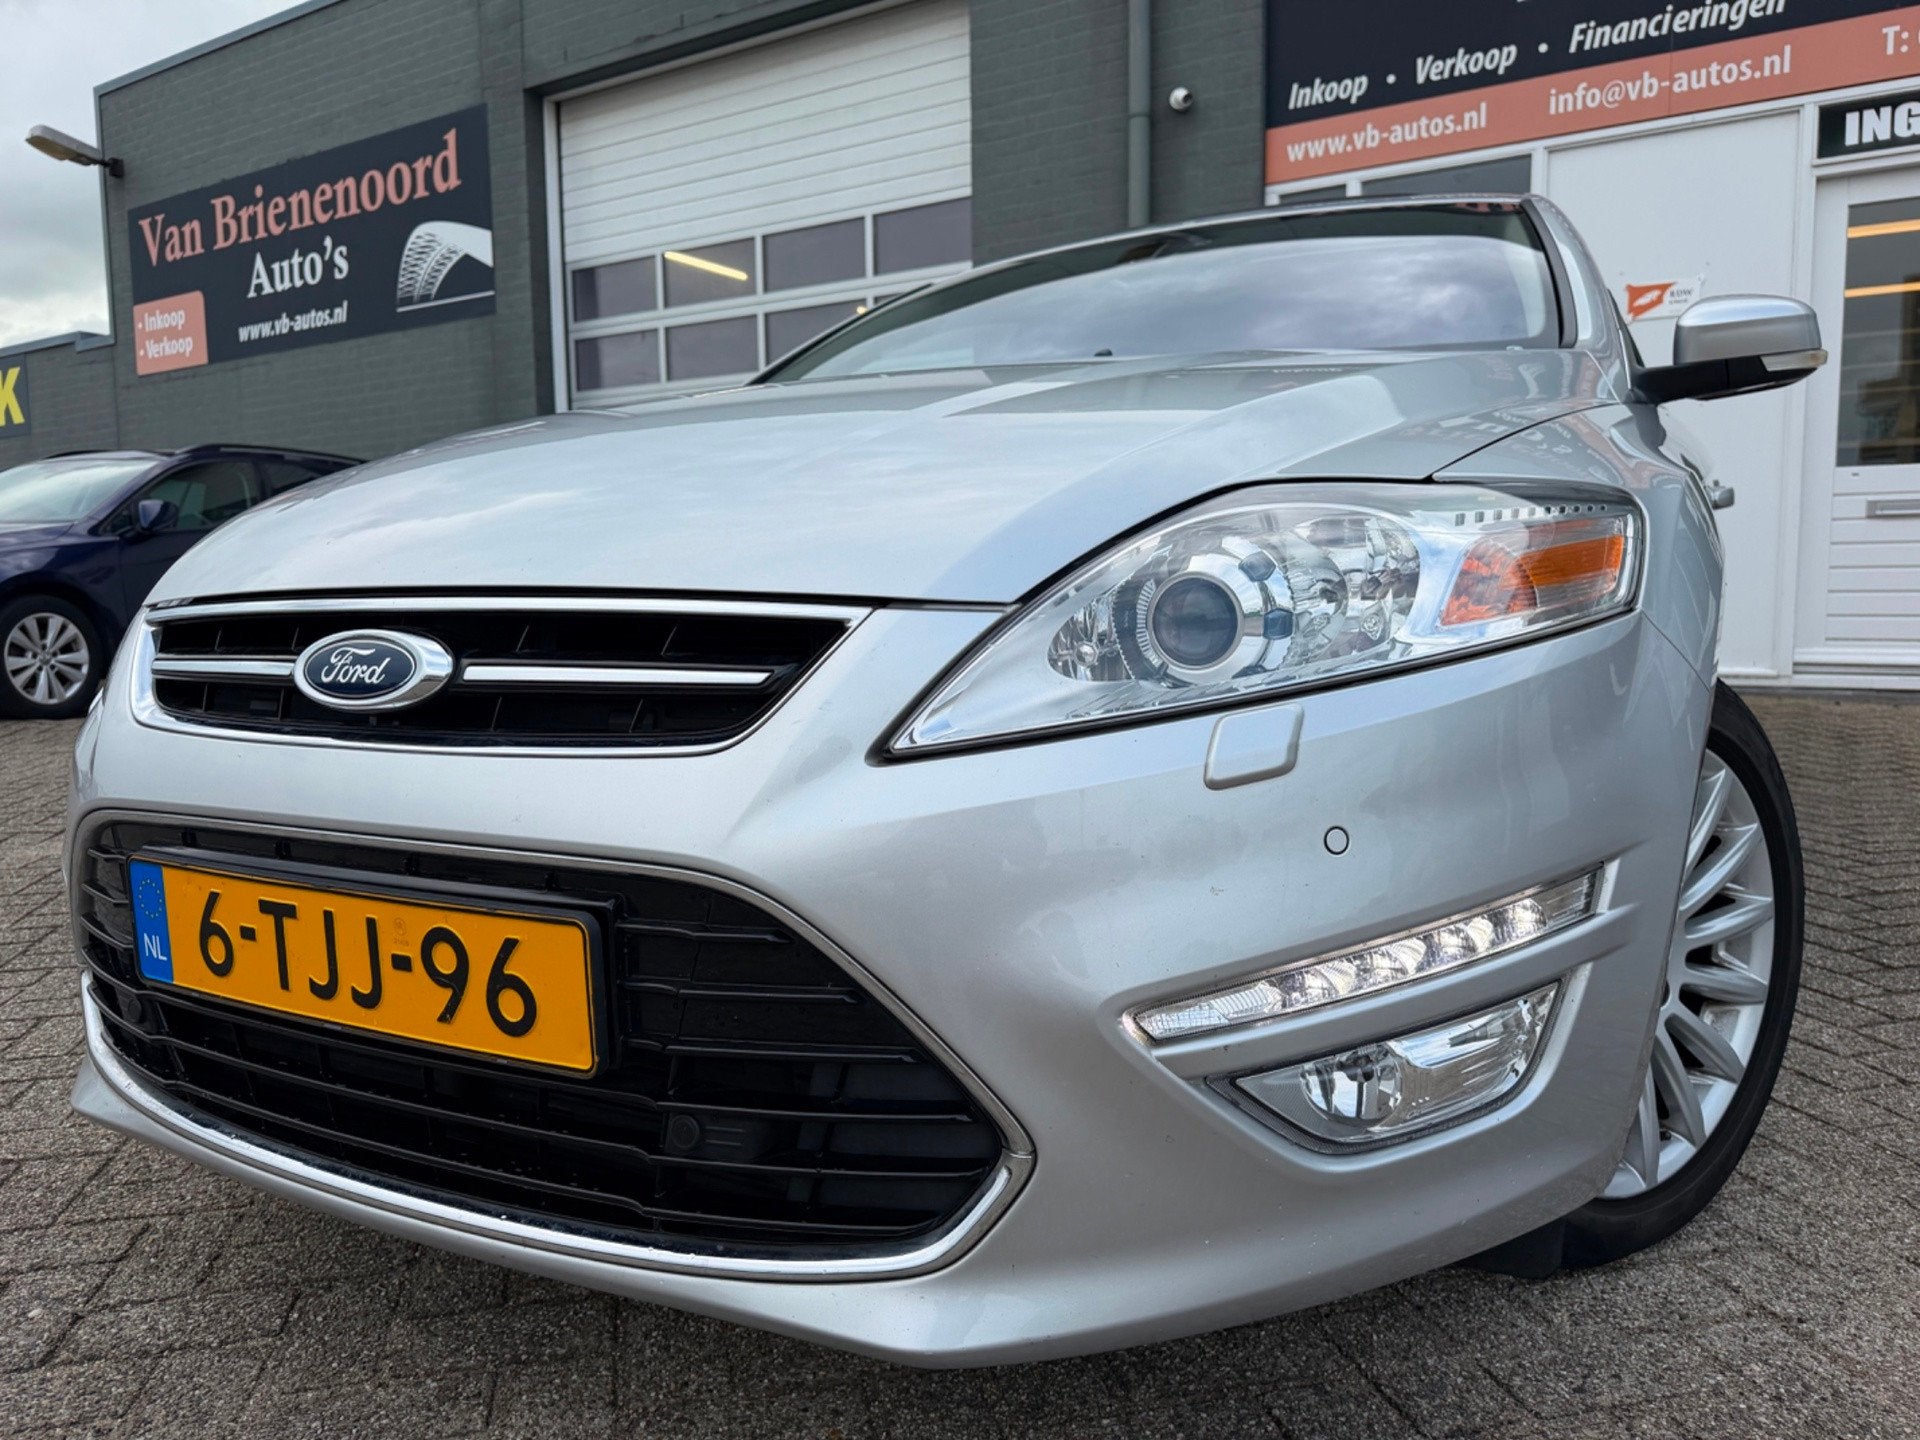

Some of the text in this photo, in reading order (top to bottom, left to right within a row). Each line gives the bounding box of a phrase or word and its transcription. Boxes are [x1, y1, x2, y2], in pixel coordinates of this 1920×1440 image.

[1288, 0, 1786, 110] Inkoop Verkoop Financieringen
[1286, 25, 1909, 162] www.vb-autos.nl info@vb-autos.nl T:
[138, 127, 462, 266] Van Brienenoord
[247, 235, 349, 298] Auto's
[144, 309, 186, 332] Inkoop
[238, 300, 348, 343] www.vb-autos.nl
[146, 336, 193, 359] Verkoop
[321, 647, 391, 685] Ford
[144, 933, 168, 962] NL
[199, 889, 538, 1038] 6-TJJ-96
